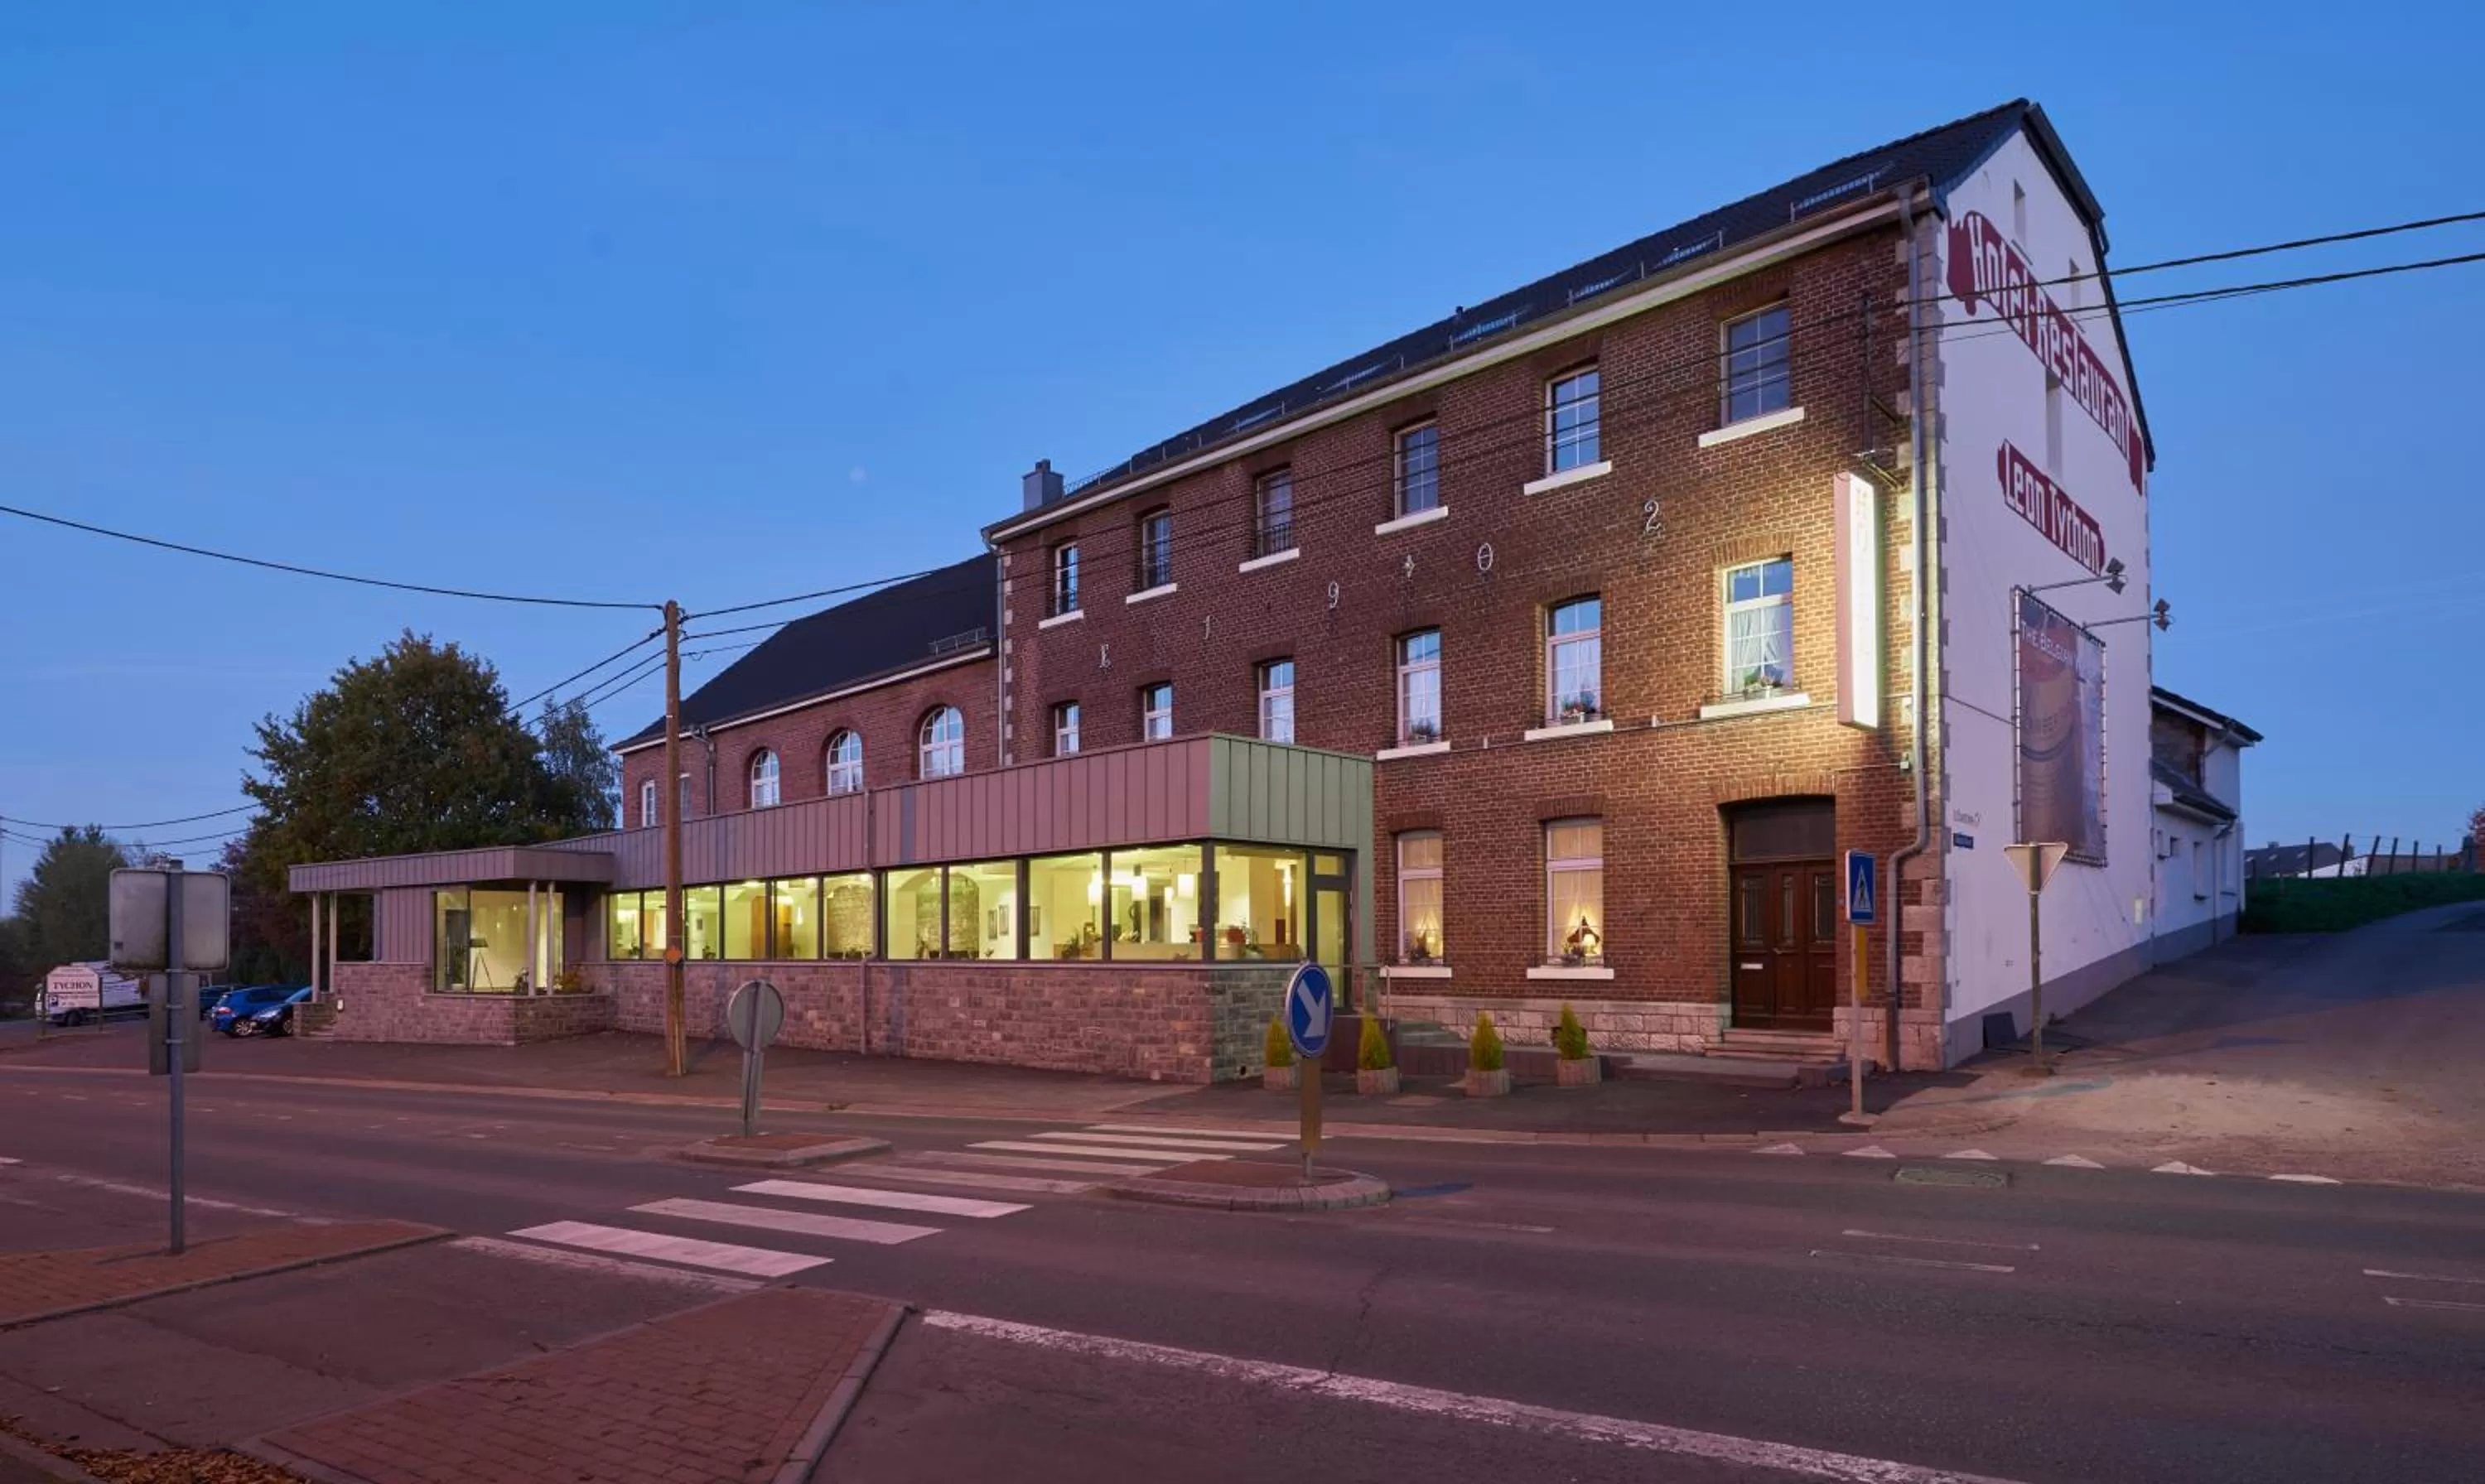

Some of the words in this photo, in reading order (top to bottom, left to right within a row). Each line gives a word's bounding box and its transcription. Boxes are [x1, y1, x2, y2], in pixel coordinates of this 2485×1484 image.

[1328, 581, 1339, 610] 9
[1644, 499, 1662, 532] 2
[2048, 483, 2101, 577] Tychon
[52, 980, 94, 990] TYCHON
